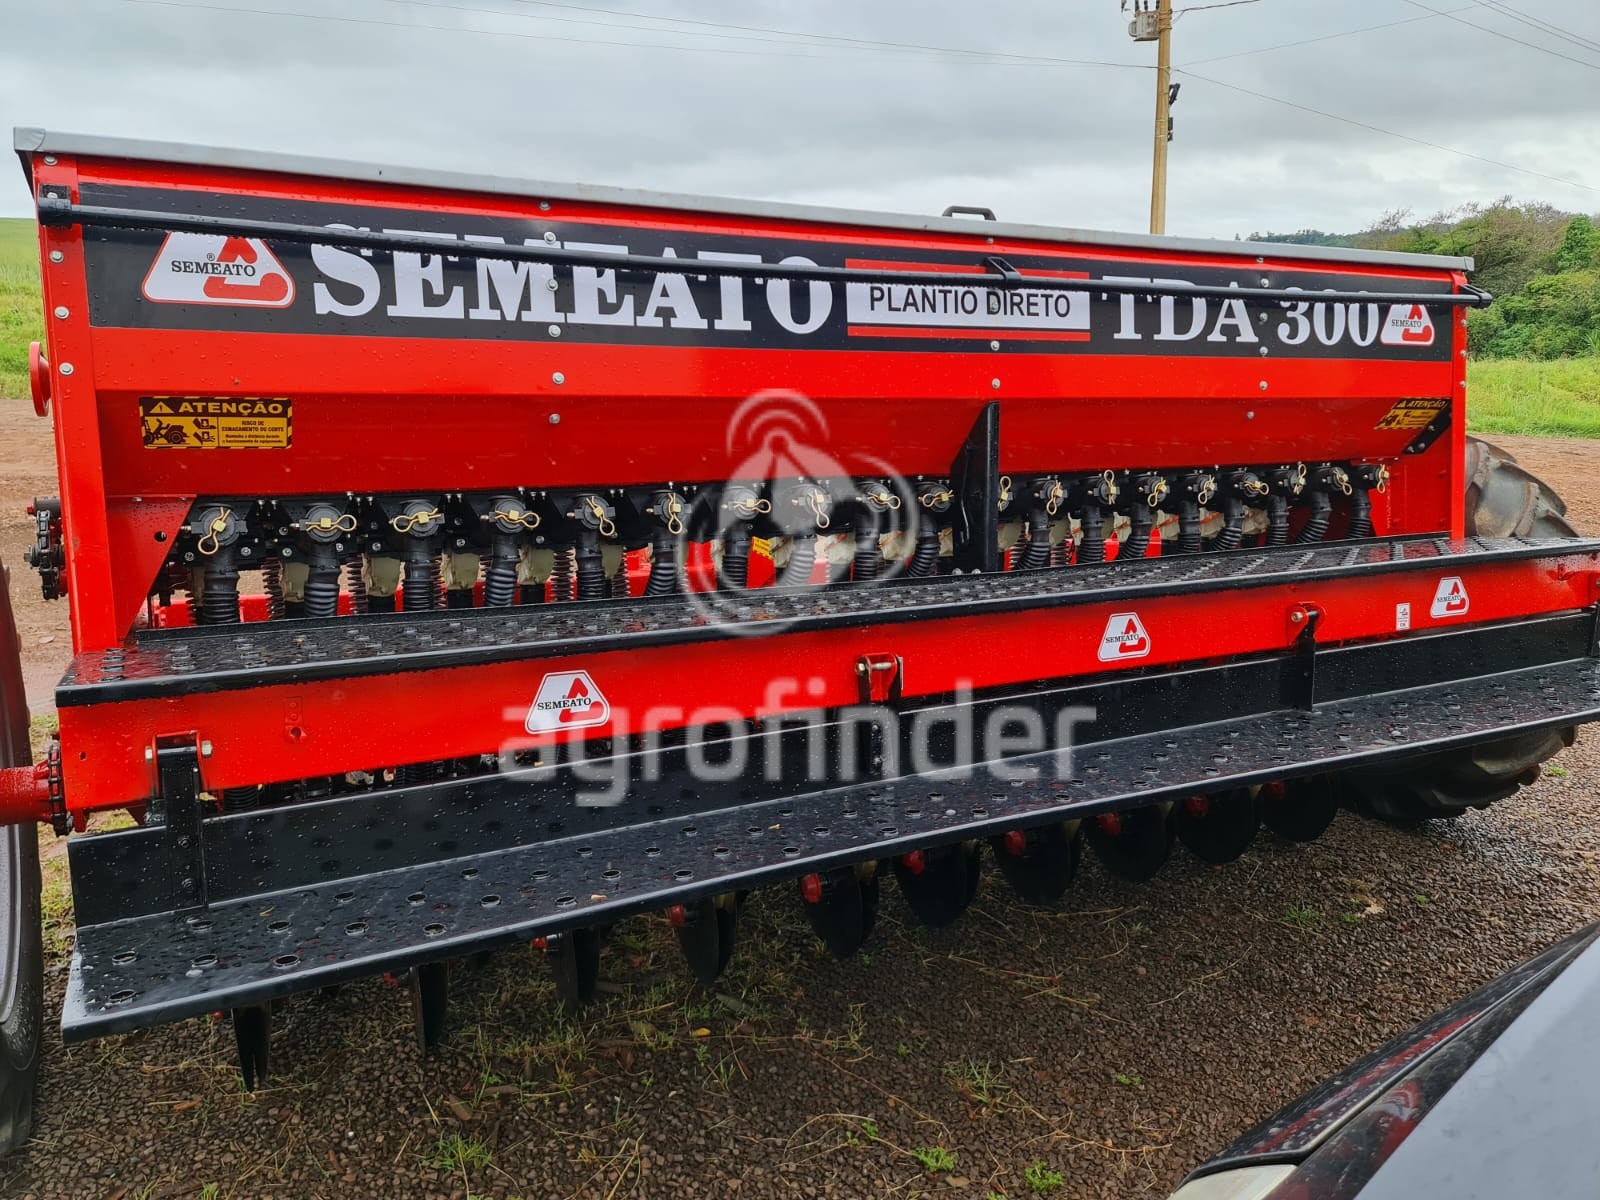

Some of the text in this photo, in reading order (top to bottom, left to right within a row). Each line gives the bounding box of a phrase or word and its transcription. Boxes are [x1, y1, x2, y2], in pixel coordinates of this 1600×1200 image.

[171, 260, 256, 277] SEMEATO
[309, 223, 833, 334] SEMEATO
[870, 286, 1070, 318] PLANTIO DIRETO
[1102, 275, 1379, 347] TDA 300
[1391, 319, 1422, 328] SEMEATO
[178, 401, 283, 416] ATENÇÃO
[1105, 634, 1139, 643] SEMEATO
[537, 697, 592, 711] SEMEATO
